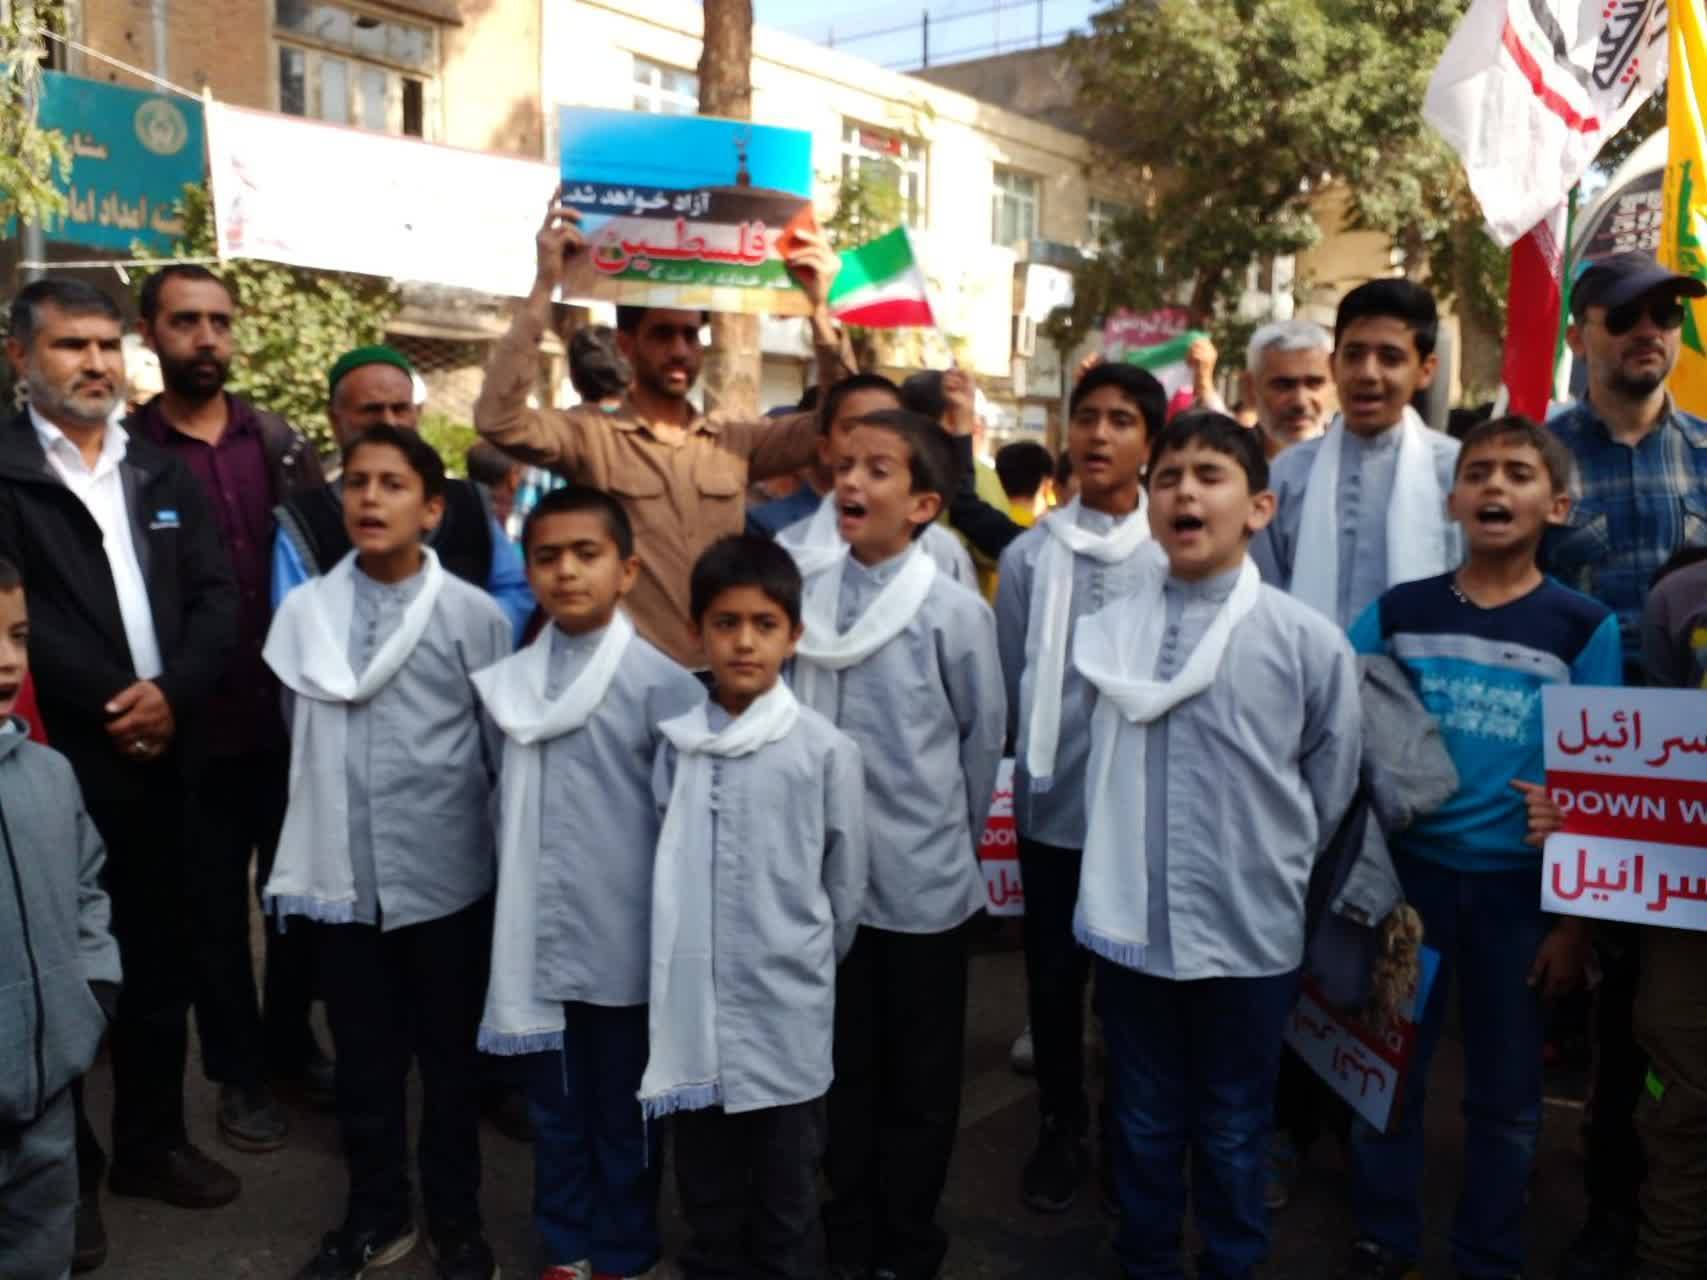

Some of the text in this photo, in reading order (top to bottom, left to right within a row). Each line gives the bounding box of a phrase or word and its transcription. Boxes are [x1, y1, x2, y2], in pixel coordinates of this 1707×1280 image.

[672, 191, 711, 217] آزاد
[591, 215, 769, 275] فلسطین
[1552, 788, 1666, 821] DOWN
